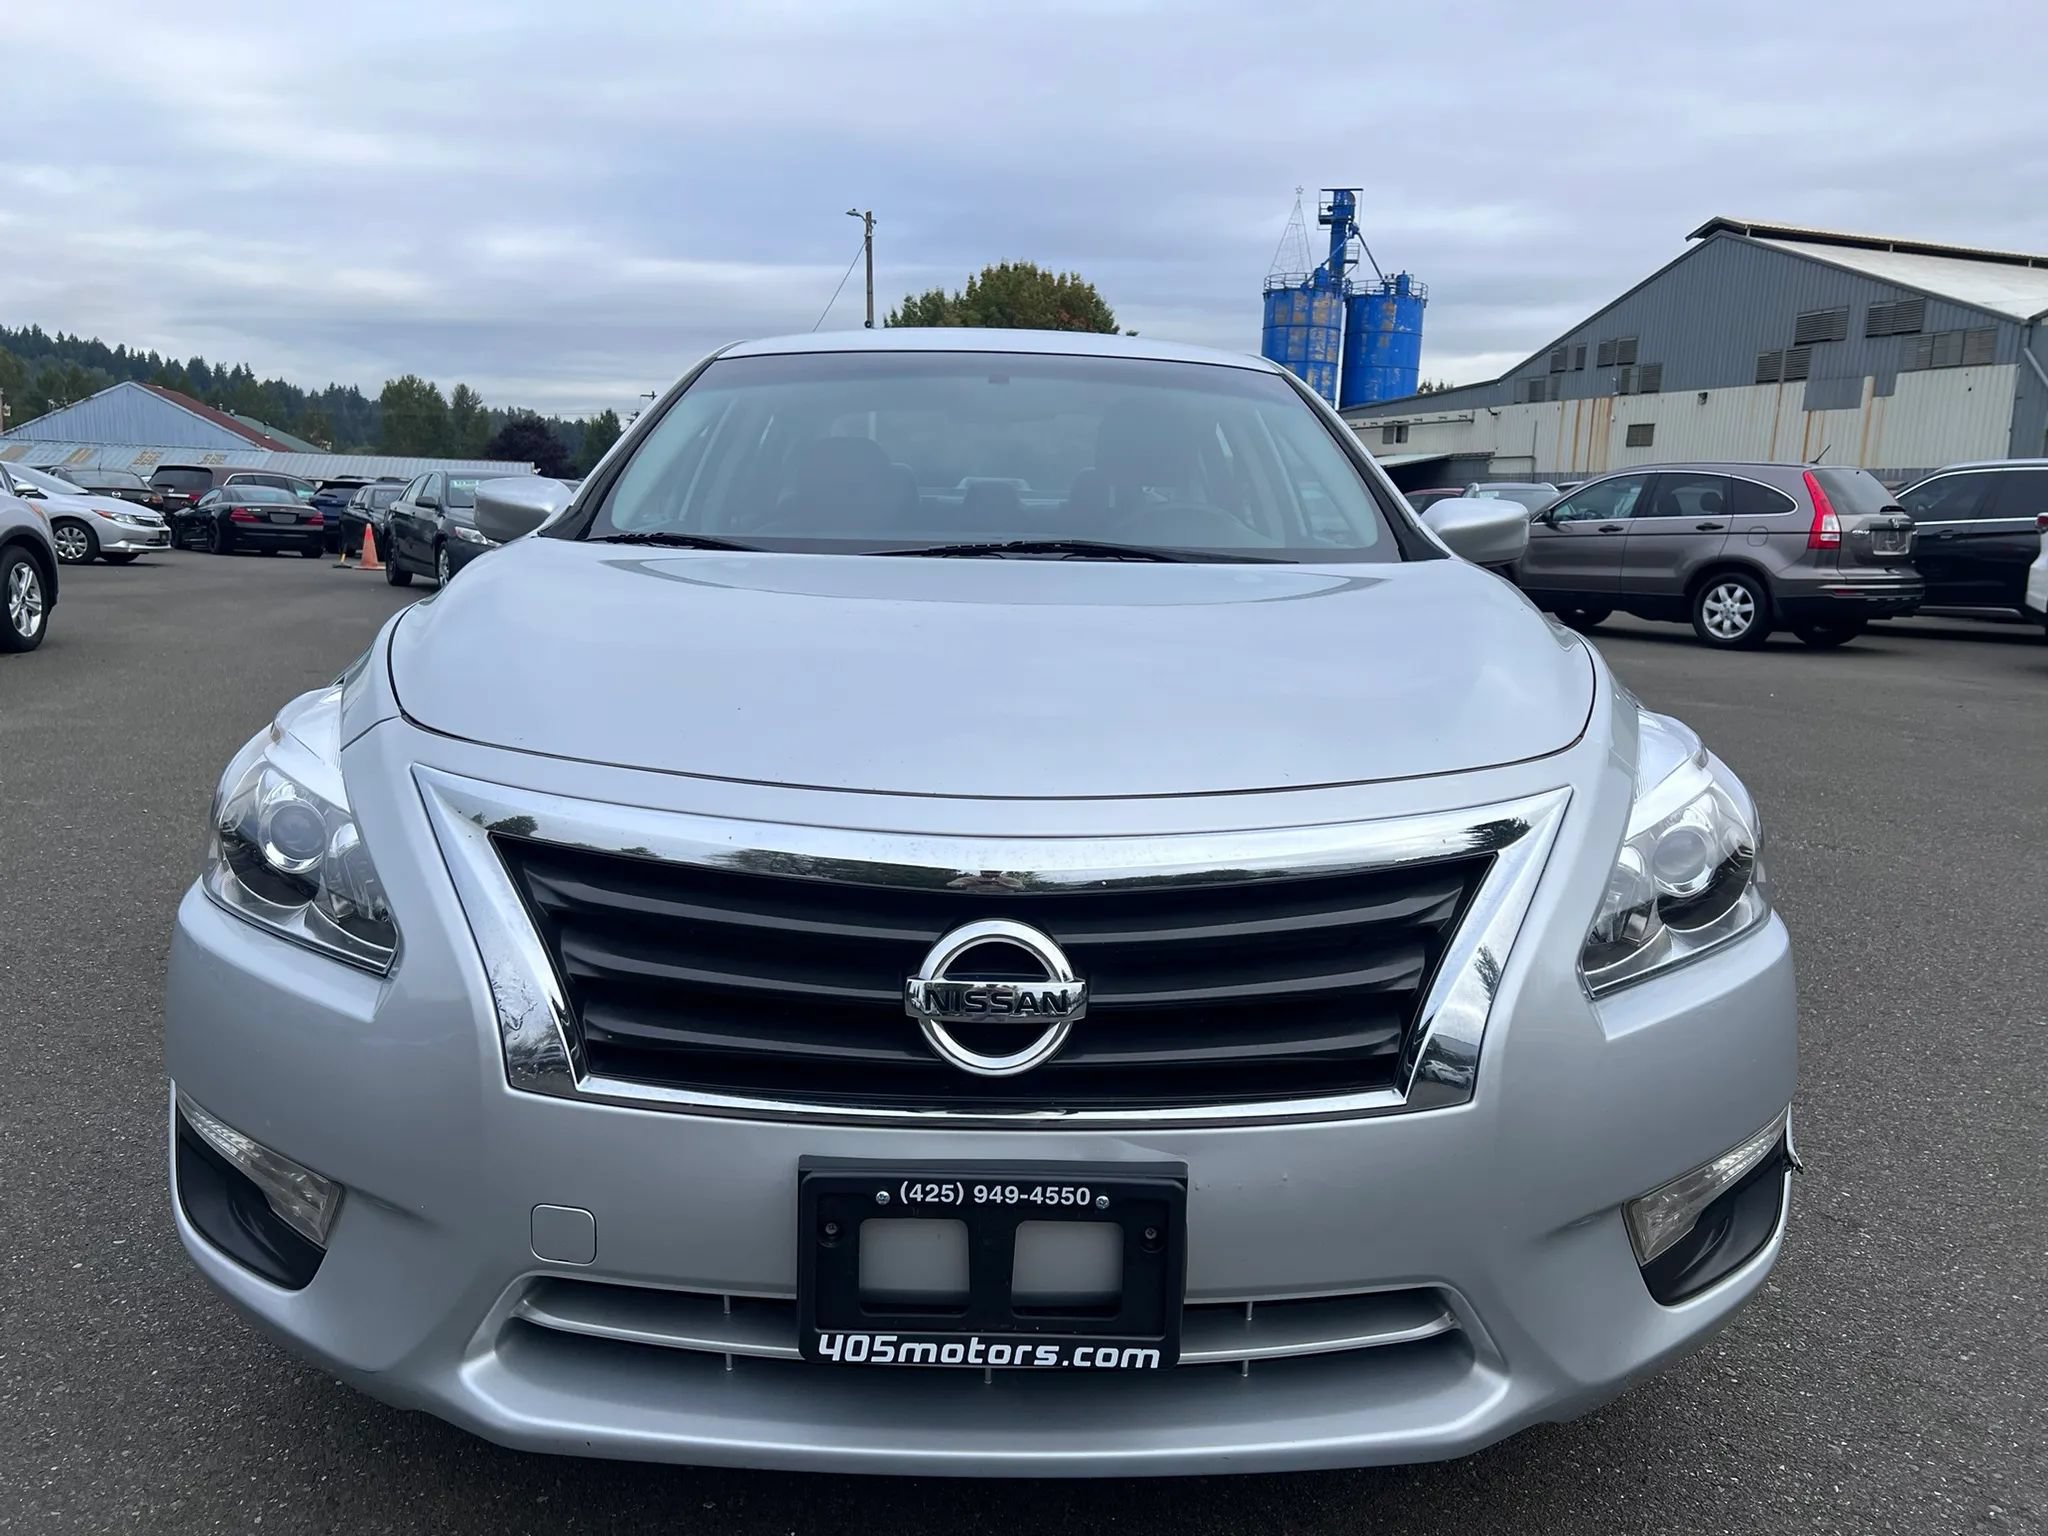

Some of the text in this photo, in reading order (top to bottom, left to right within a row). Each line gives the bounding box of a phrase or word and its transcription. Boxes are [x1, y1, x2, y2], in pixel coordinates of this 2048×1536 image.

[924, 989, 1068, 1015] NISSAN
[900, 1181, 1090, 1206] (425) 949-4550
[818, 1333, 1160, 1369] 405motors.com
